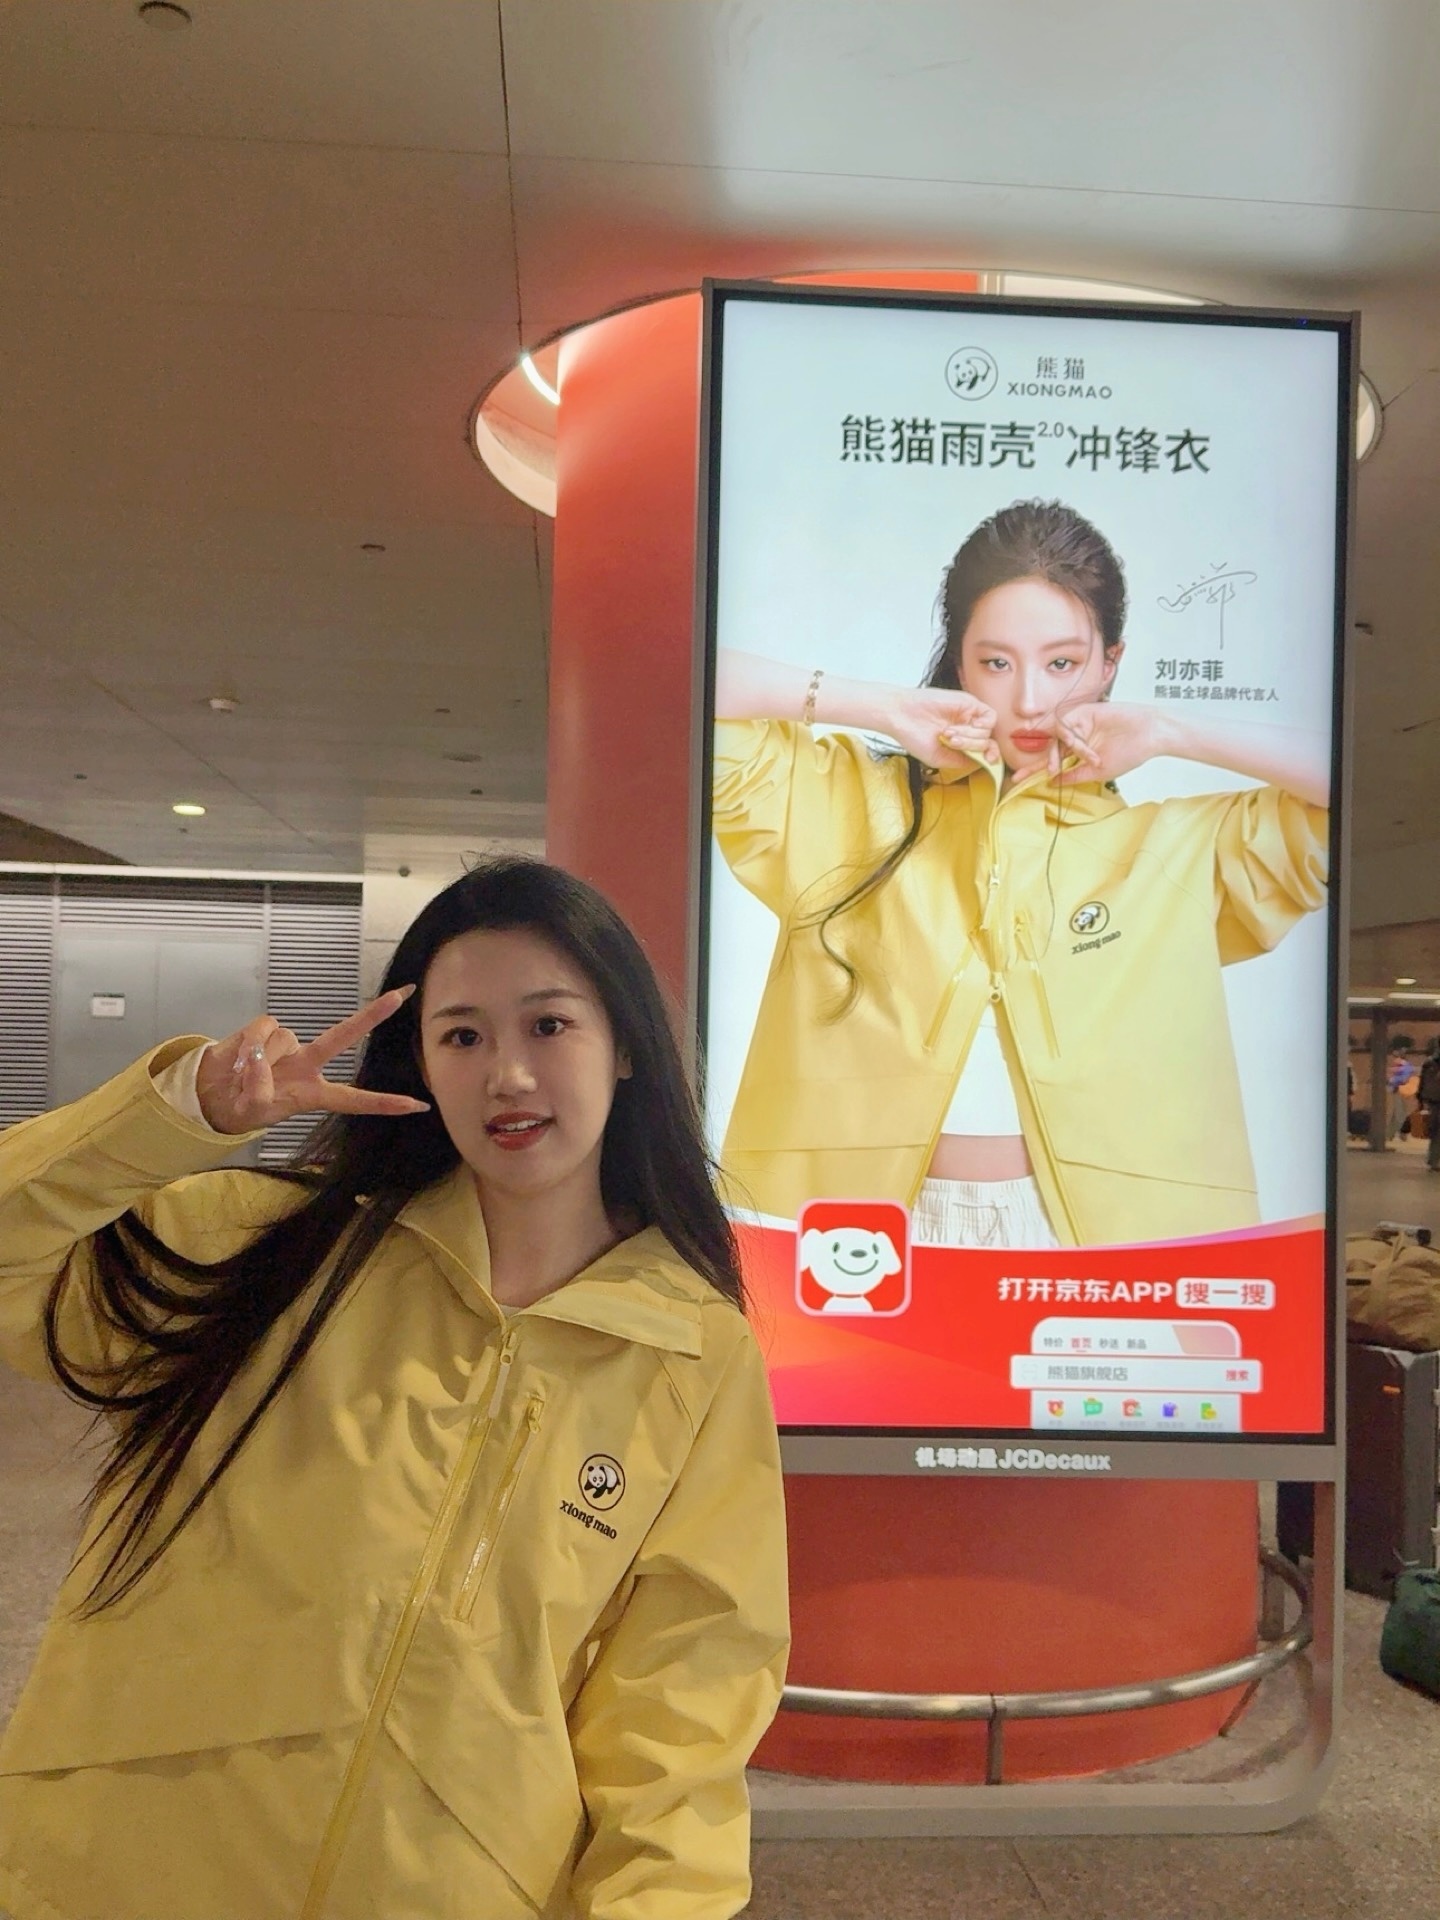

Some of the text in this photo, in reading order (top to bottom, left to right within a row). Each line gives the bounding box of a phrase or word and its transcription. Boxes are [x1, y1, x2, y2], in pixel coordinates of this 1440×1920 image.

[1036, 355, 1085, 381] 熊猫
[1006, 381, 1113, 400] XIONGMAO
[1154, 658, 1225, 682] 刘亦菲
[1153, 685, 1280, 702] 熊猫全球品牌代言人
[997, 1277, 1267, 1306] 打开京东APP 搜一搜
[1070, 1337, 1092, 1349] 首页
[1047, 1365, 1250, 1381] 熊猫旗舰店 搜索
[999, 1448, 1112, 1470] JCDecaux
[560, 1500, 617, 1539] xiong mao
